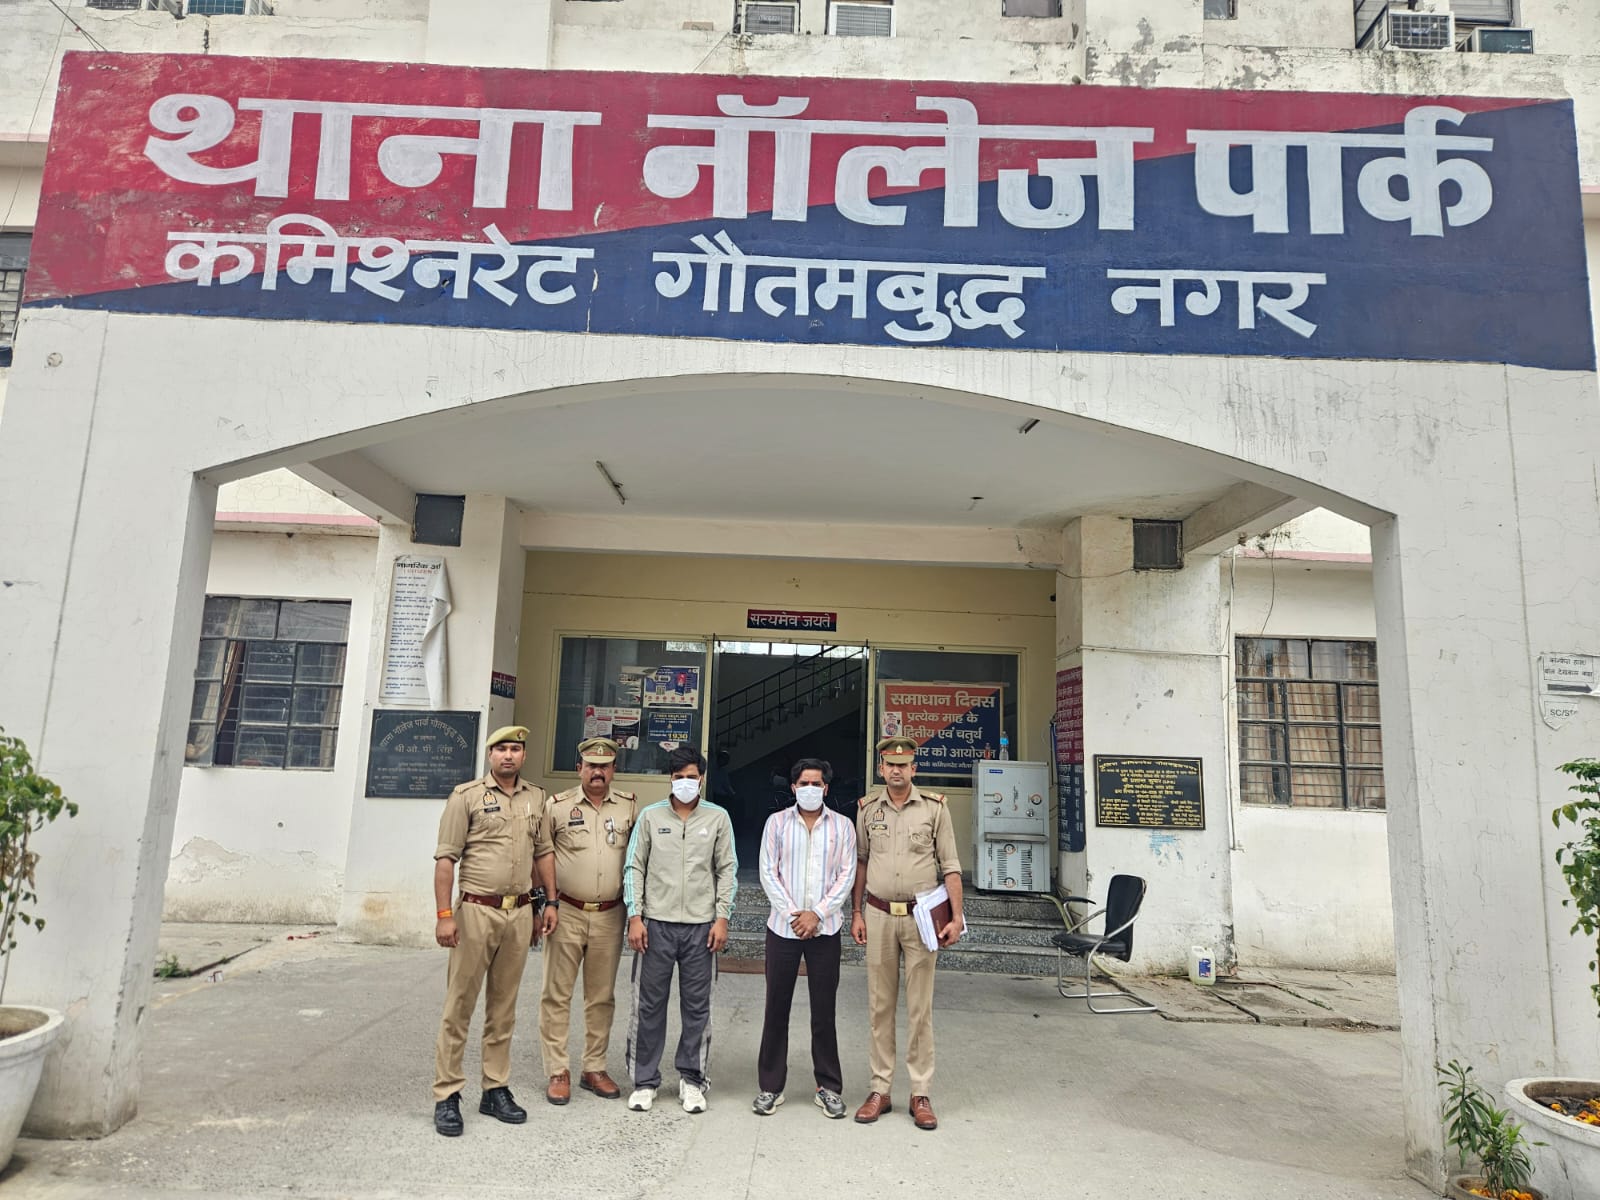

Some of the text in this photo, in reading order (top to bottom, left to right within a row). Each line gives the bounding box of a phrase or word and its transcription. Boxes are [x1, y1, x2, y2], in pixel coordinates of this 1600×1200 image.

[144, 93, 1494, 238] थाना नॉलेज पार्क
[165, 213, 1327, 342] कमिश्नरेट गौतमबुद्ध नगर
[750, 611, 831, 628] सत्यमेव जयते
[890, 691, 996, 708] समाधान दिवस
[906, 709, 980, 724] प्रत्येक माह के
[903, 725, 983, 744] द्वितीय एवं चतुर्थ
[931, 745, 946, 757] को
